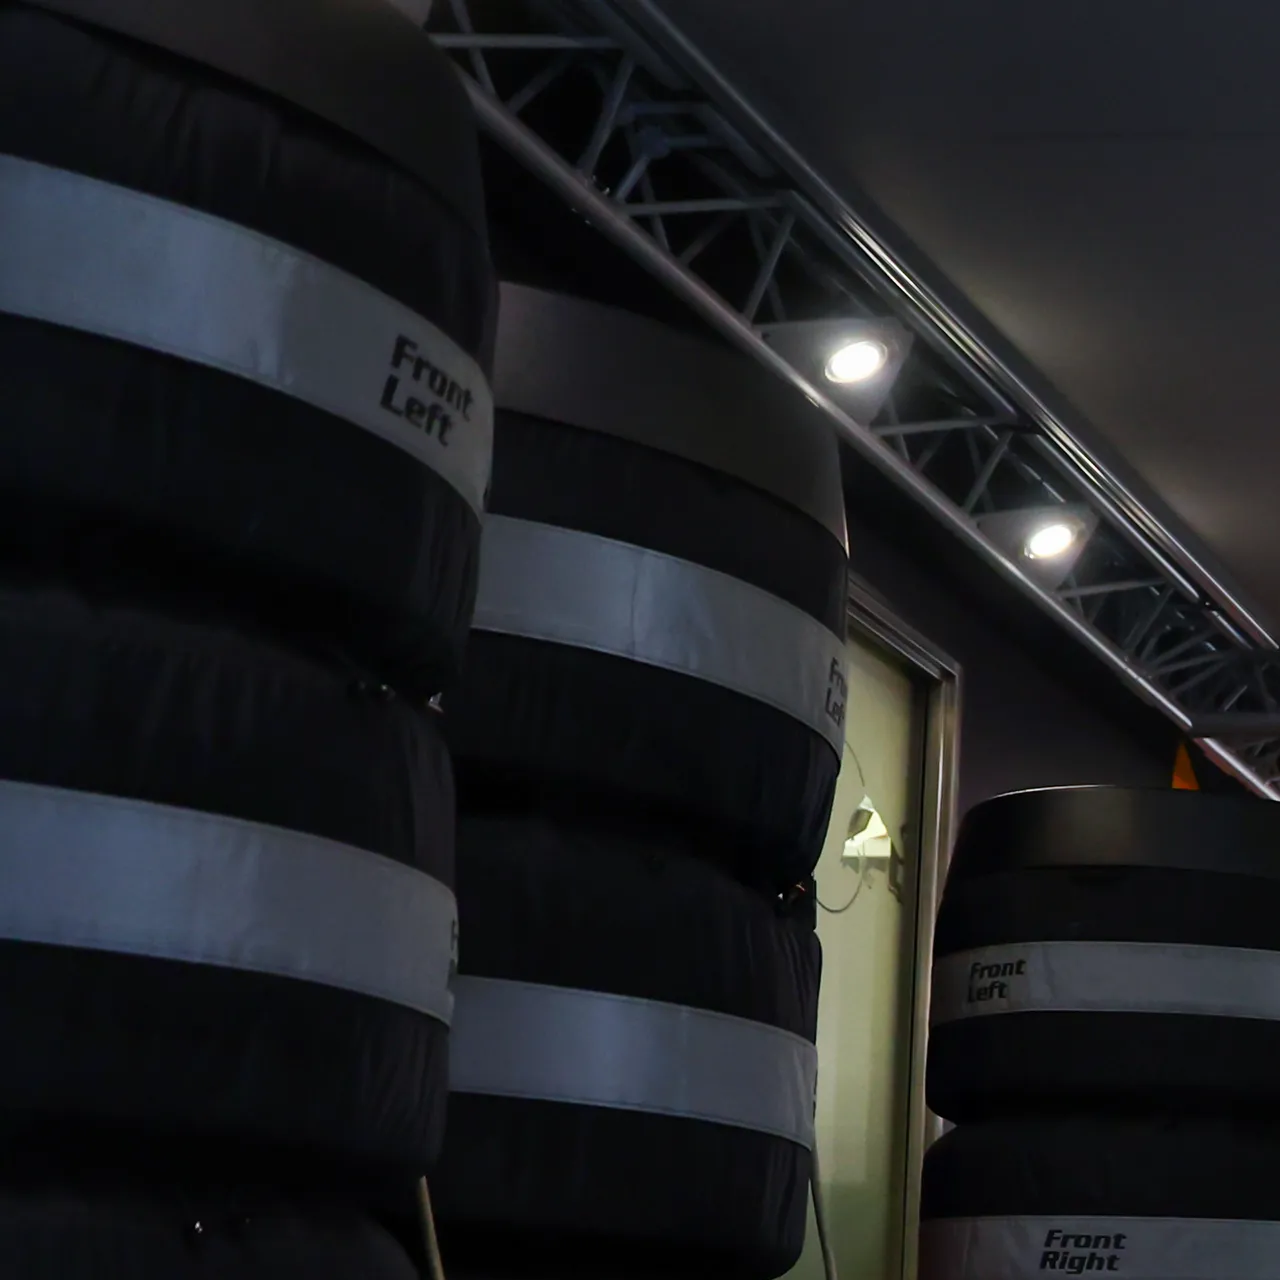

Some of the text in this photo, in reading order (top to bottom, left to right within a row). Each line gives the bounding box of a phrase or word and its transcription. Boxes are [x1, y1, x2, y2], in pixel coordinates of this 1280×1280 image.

[391, 333, 474, 423] Front
[380, 374, 451, 447] Left
[971, 959, 1026, 979] Front
[967, 980, 1007, 1003] Left
[1044, 1229, 1127, 1250] Front
[1040, 1250, 1120, 1275] Right
